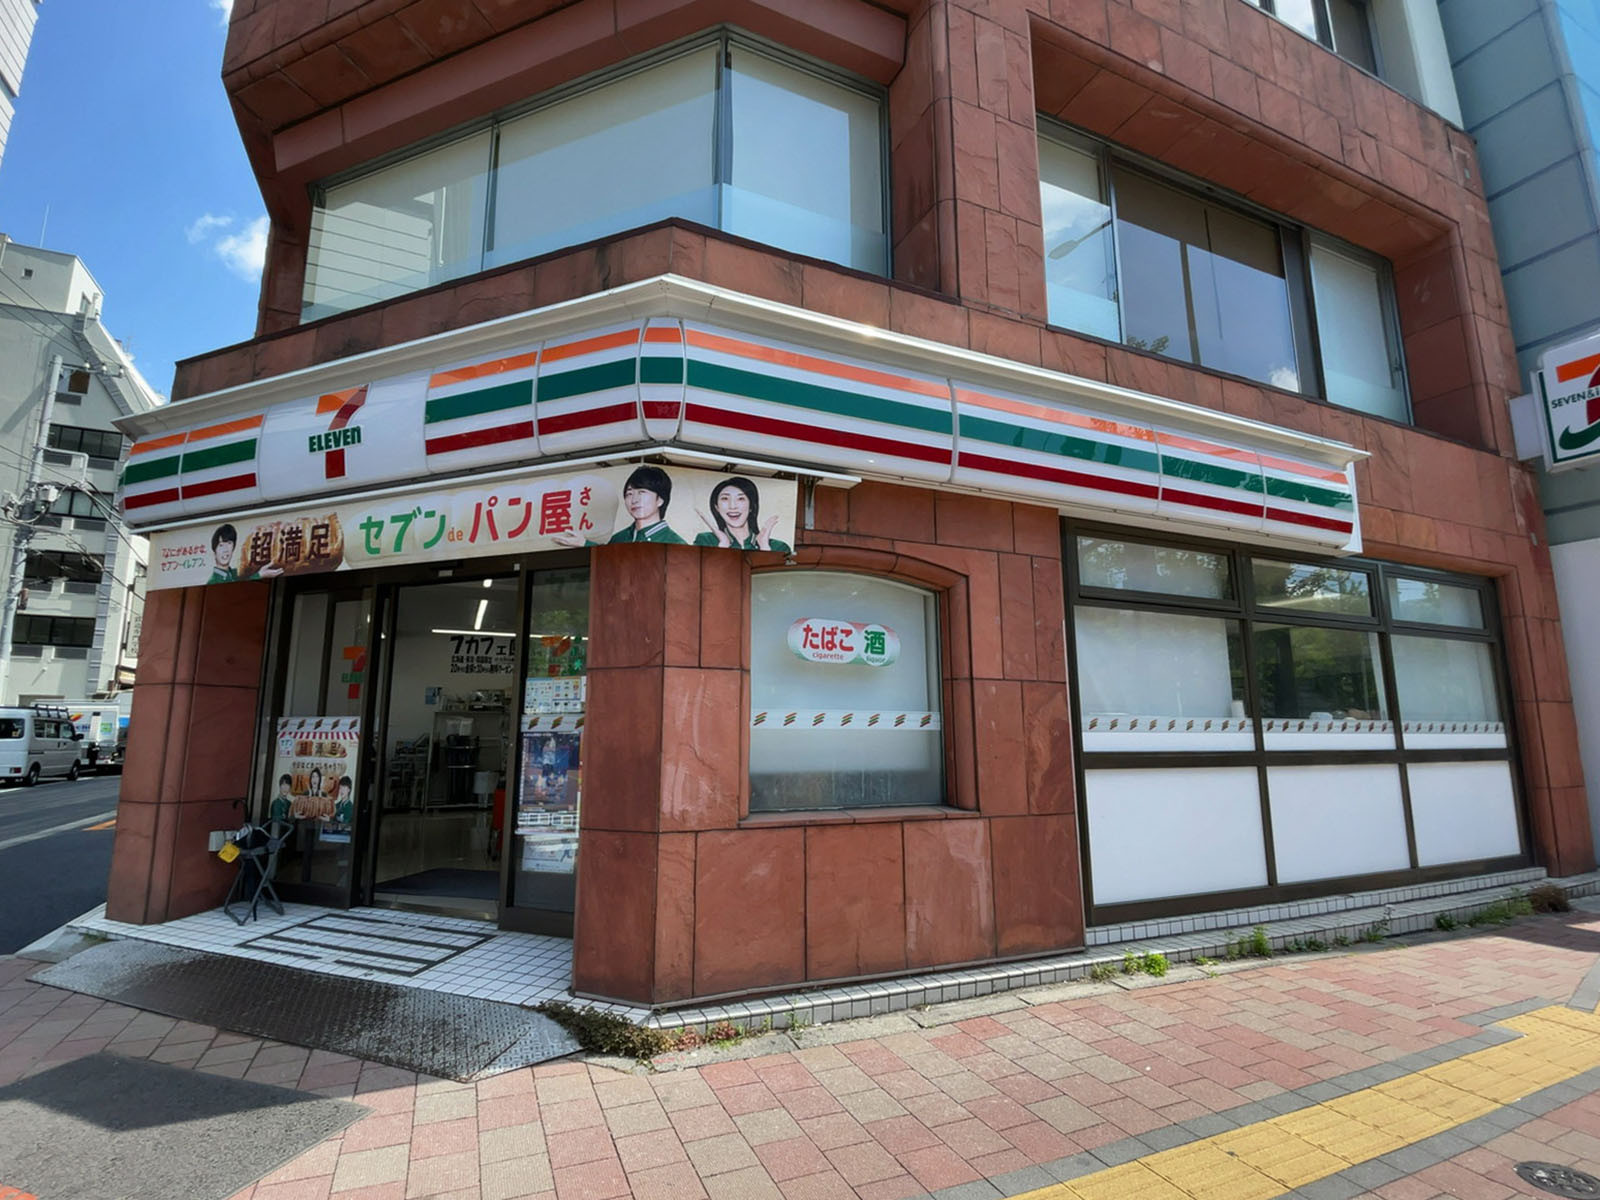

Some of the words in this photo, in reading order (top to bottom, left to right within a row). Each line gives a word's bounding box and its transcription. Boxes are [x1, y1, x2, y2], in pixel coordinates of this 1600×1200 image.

[359, 506, 447, 555] セブン
[447, 528, 464, 543] de
[468, 490, 574, 544] パン屋
[580, 486, 594, 531] さん
[250, 523, 332, 565] 超満足
[802, 624, 855, 652] たばこ
[864, 629, 886, 655] 酒
